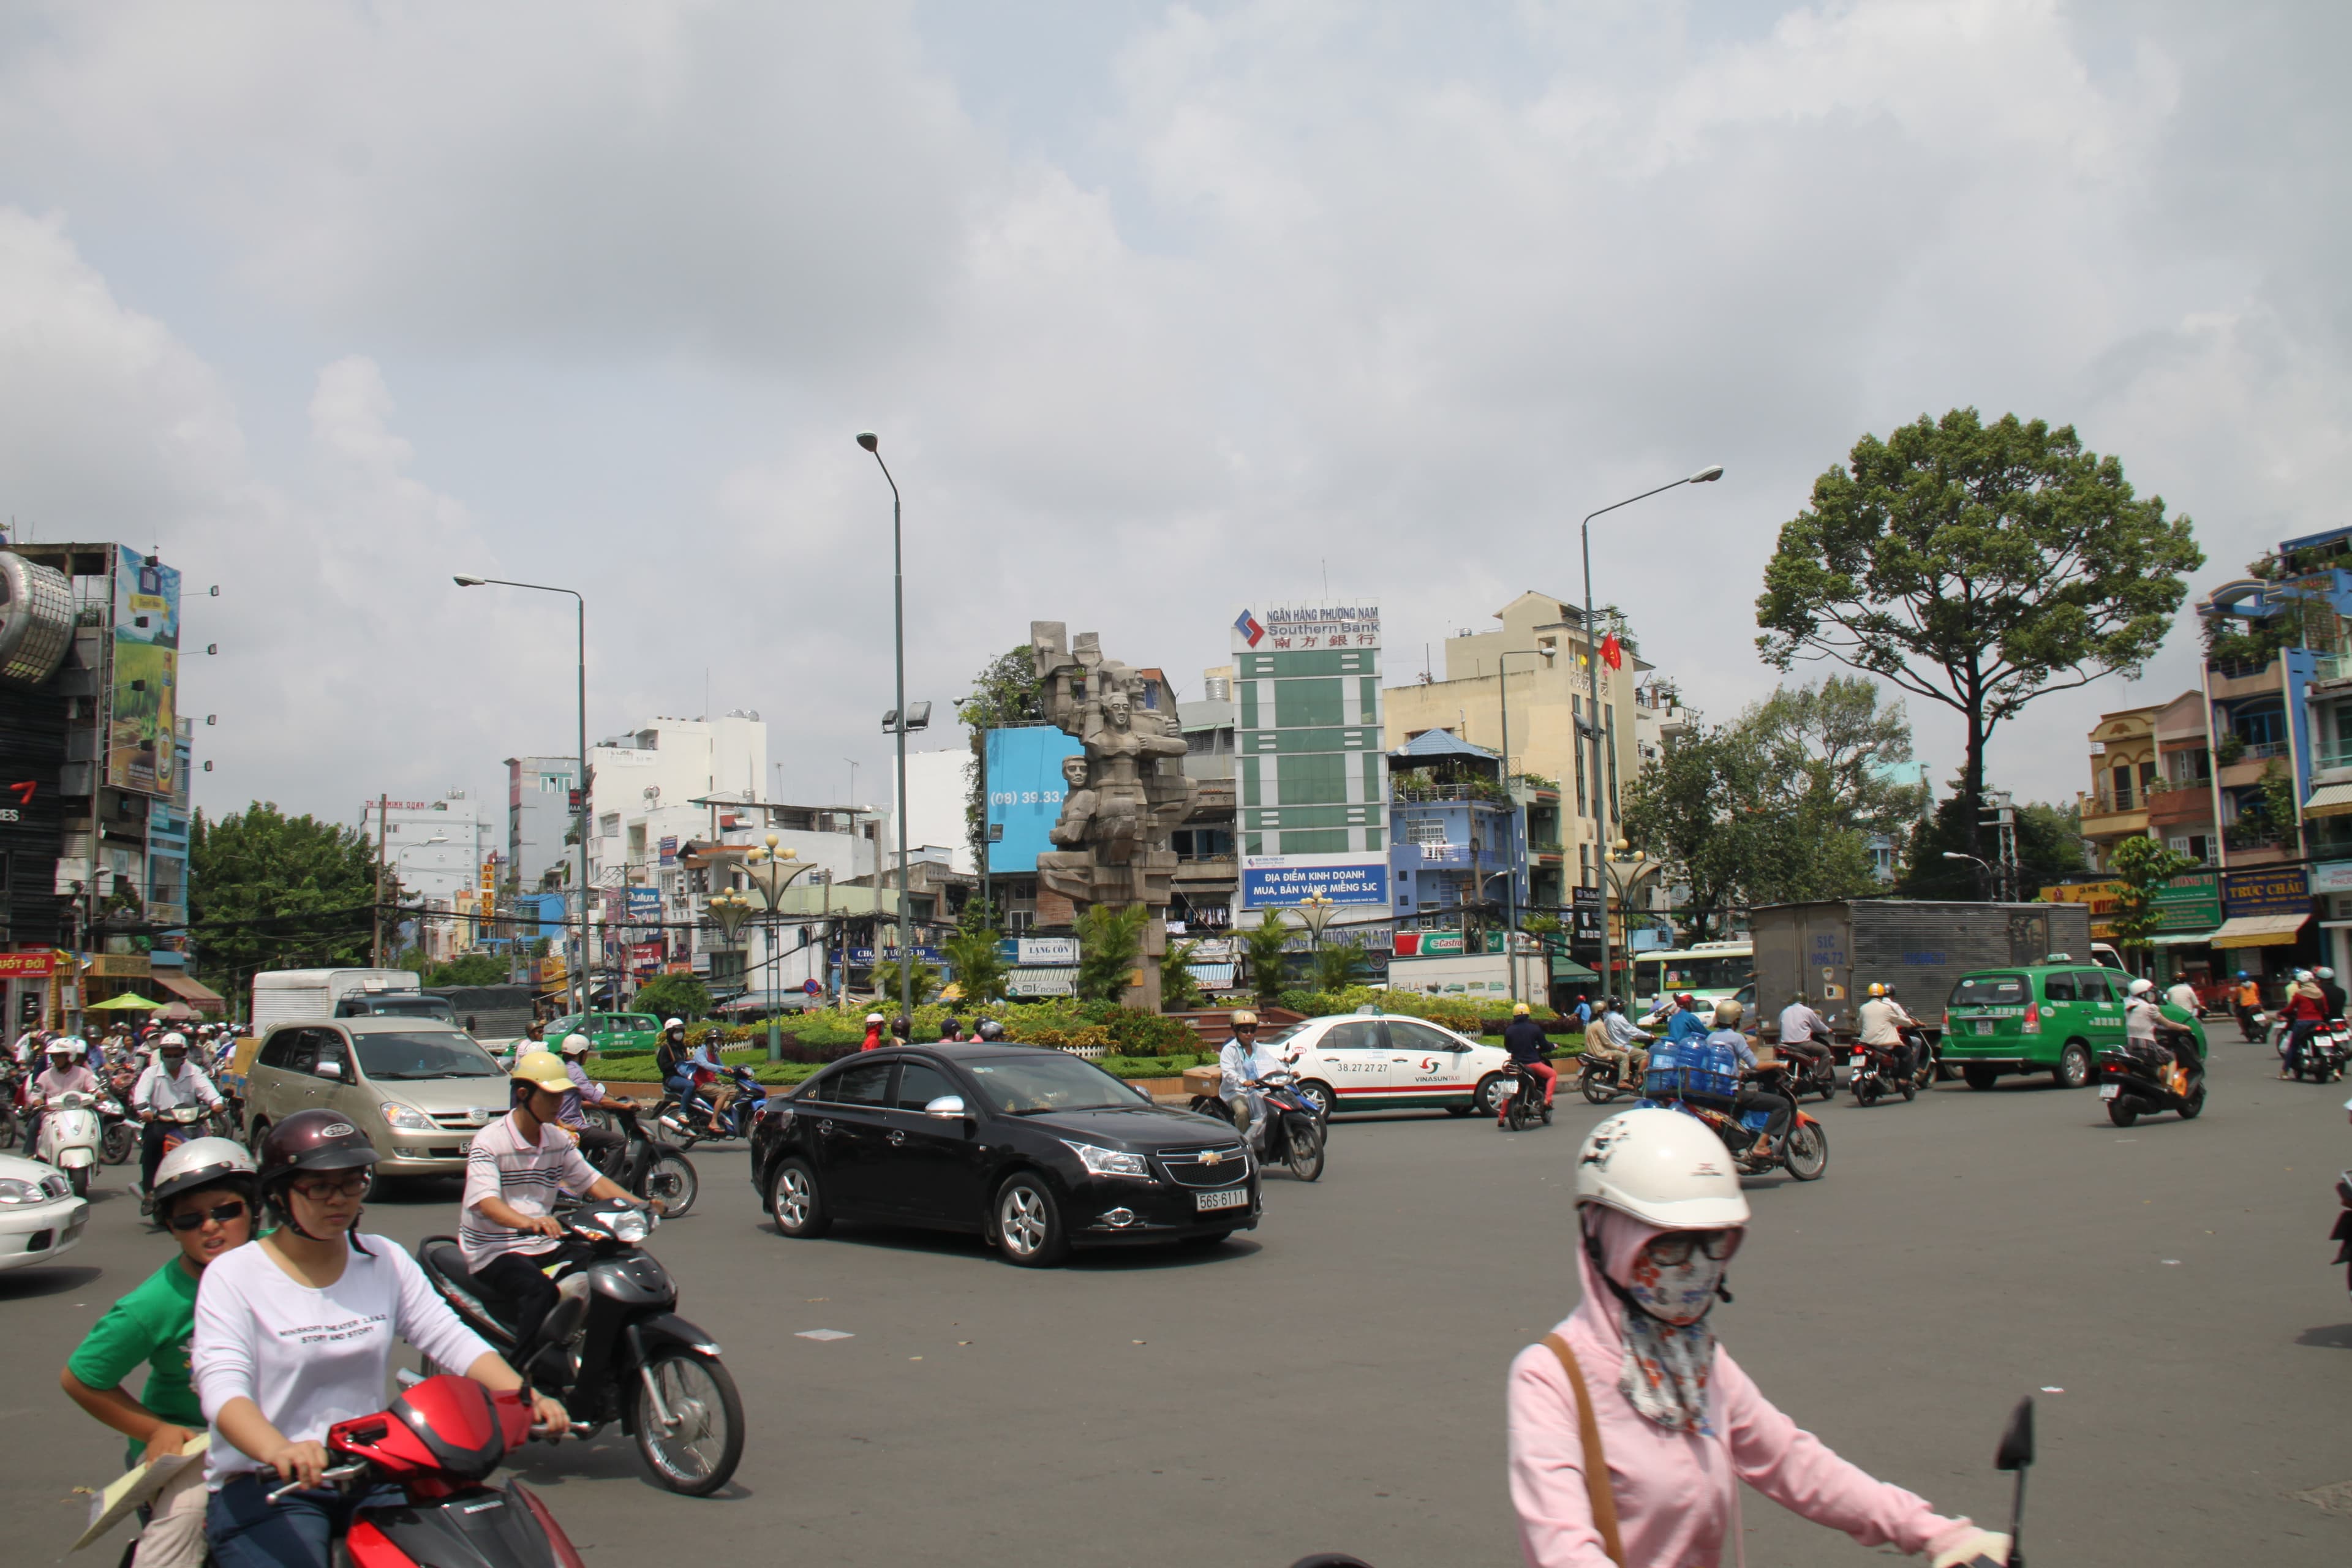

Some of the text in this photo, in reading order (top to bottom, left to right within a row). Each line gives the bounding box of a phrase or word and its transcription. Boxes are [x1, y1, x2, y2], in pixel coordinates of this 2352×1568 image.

[1267, 608, 1291, 622] NGÂN
[1293, 606, 1317, 620] HÀNG
[1358, 606, 1378, 619] NAM
[1268, 622, 1380, 636] Southern Bank
[990, 790, 1068, 807] (08) 39.33.
[1265, 868, 1365, 884] ĐỊA ĐIỂM KINH DOANH
[1254, 886, 1277, 895] MUA,
[1280, 884, 1299, 894] BÁN
[1362, 883, 1378, 891] SJC
[1817, 935, 1834, 948] 51C
[1337, 1063, 1362, 1072] 38.27
